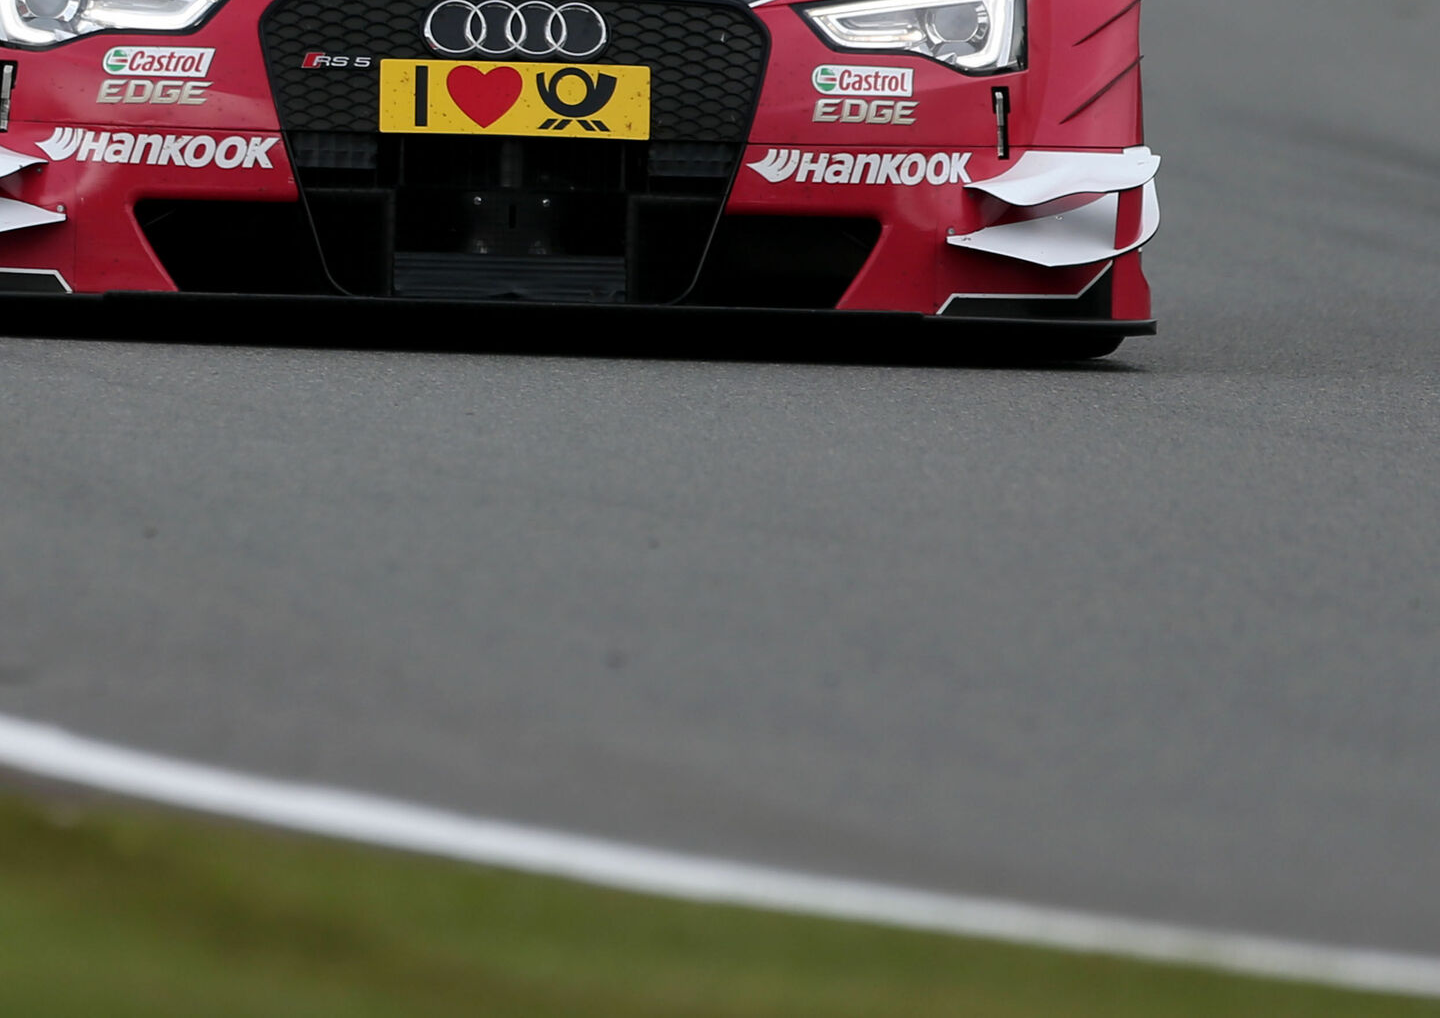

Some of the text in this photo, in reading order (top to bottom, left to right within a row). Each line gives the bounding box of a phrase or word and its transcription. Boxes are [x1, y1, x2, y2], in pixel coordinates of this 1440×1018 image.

[127, 49, 206, 74] Castrol
[312, 55, 372, 68] RS 5
[95, 79, 214, 105] EDGE
[838, 69, 908, 92] Castrol
[811, 98, 920, 125] EDGE
